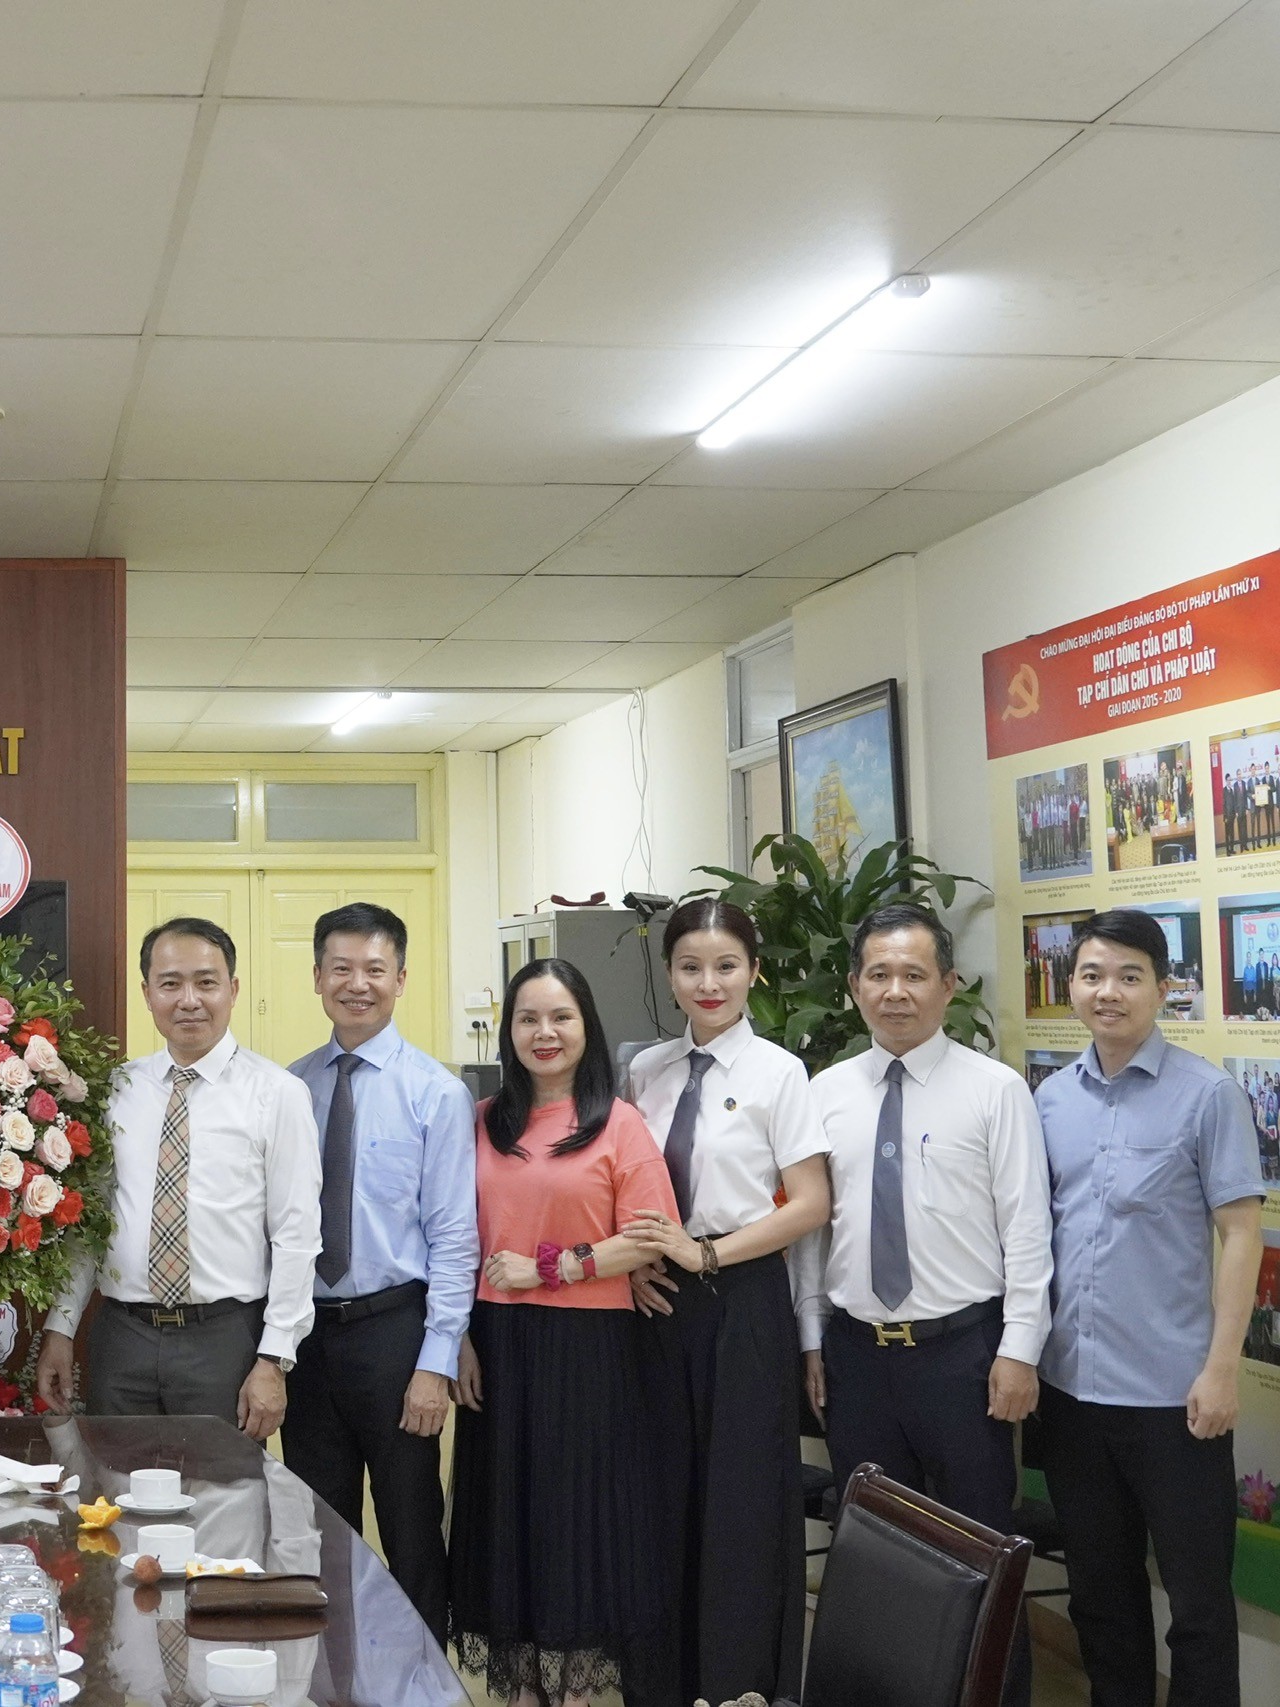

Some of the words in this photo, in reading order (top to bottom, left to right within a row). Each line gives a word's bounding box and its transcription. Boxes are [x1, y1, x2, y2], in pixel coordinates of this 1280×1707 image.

[1040, 644, 1057, 659] CHÀO
[1058, 637, 1078, 654] MỪNG
[1079, 633, 1090, 648] ĐẠI
[1091, 627, 1104, 644] HỘI
[1104, 622, 1117, 640] ĐẠI
[1117, 615, 1132, 635] BIỂU
[1133, 611, 1154, 629] ĐẢNG
[1155, 605, 1166, 623] BỘ
[1166, 601, 1178, 619] BỘ
[1177, 597, 1189, 614] TƯ
[1189, 591, 1212, 610] PHÁP
[1230, 577, 1250, 596] THỨ
[1250, 576, 1260, 592] XI
[1077, 684, 1093, 708] TẠP
[1095, 674, 1110, 701] CHÍ
[1110, 671, 1130, 697] DÂN
[1130, 662, 1149, 691] CHỦ
[1150, 660, 1164, 685] VÀ
[1164, 654, 1189, 682] PHÁP
[1190, 646, 1216, 676] LUẬT
[1093, 649, 1115, 676] HOẠT
[1116, 642, 1140, 669] ĐỘNG
[1142, 630, 1161, 659] CỦA
[1162, 629, 1178, 653] CHI
[1179, 620, 1193, 650] BỘ
[1107, 702, 1121, 718] GIAI
[1121, 698, 1141, 715] ĐOẠN
[1142, 692, 1159, 709] 2015
[1163, 686, 1182, 704] 2020
